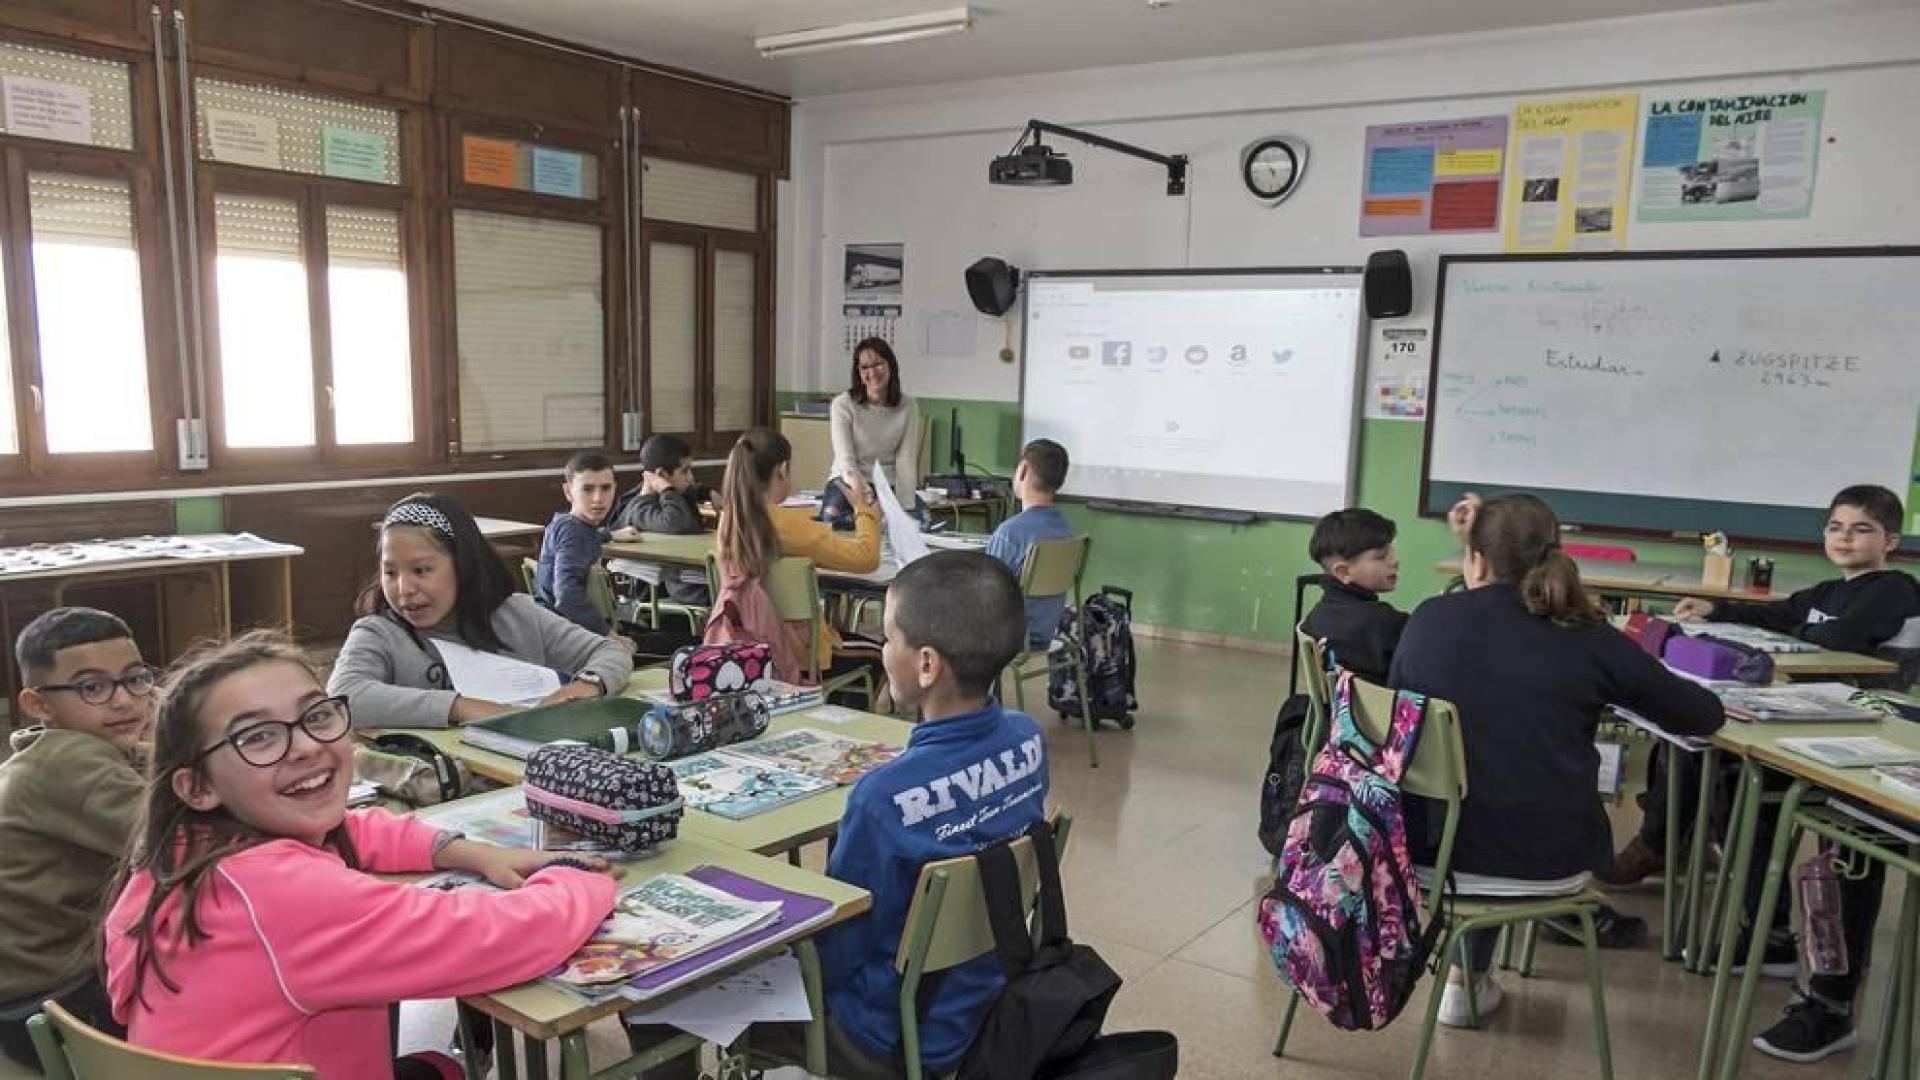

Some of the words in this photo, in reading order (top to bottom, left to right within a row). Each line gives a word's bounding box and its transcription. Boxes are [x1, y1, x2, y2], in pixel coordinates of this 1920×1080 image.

[1652, 101, 1671, 115] LA
[1710, 114, 1731, 127] DEL
[1392, 342, 1415, 352] 170
[1734, 349, 1861, 371] ZUGSPITZE
